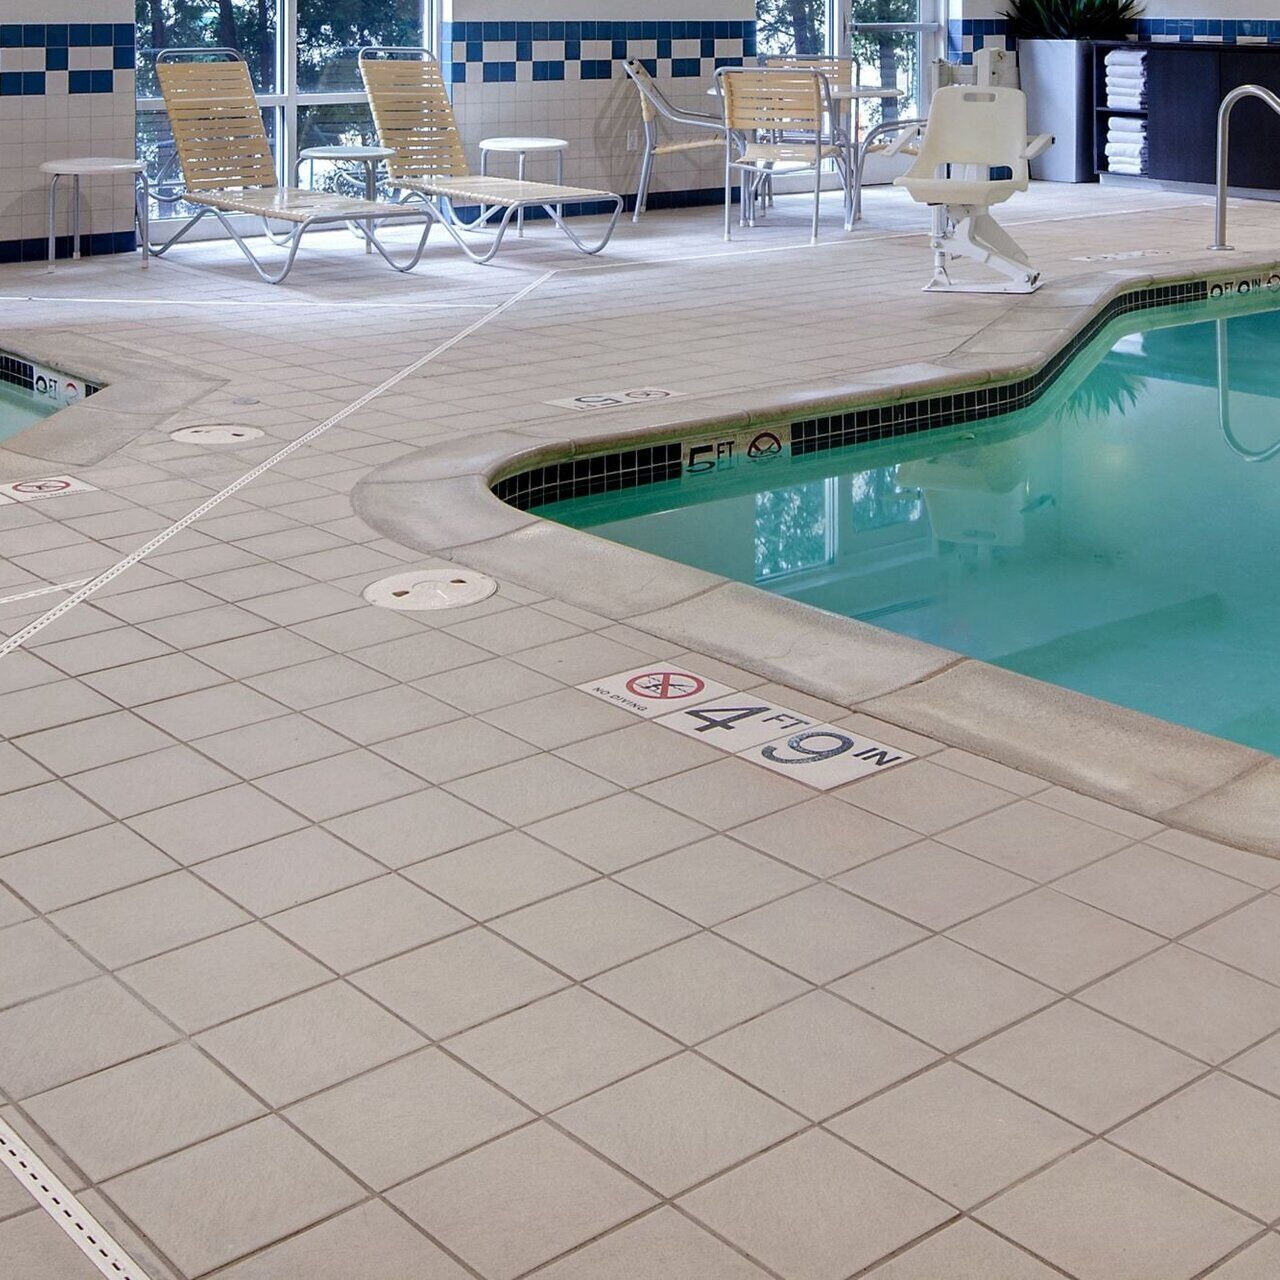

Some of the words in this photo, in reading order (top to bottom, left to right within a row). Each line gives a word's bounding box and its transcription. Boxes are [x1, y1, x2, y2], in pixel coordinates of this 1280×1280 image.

[686, 444, 716, 473] 5
[717, 440, 735, 460] FT
[592, 686, 611, 696] NO
[609, 694, 648, 712] DIVING
[684, 706, 773, 733] 4
[761, 713, 811, 730] FT
[761, 731, 855, 765] 9
[852, 746, 903, 767] IN
